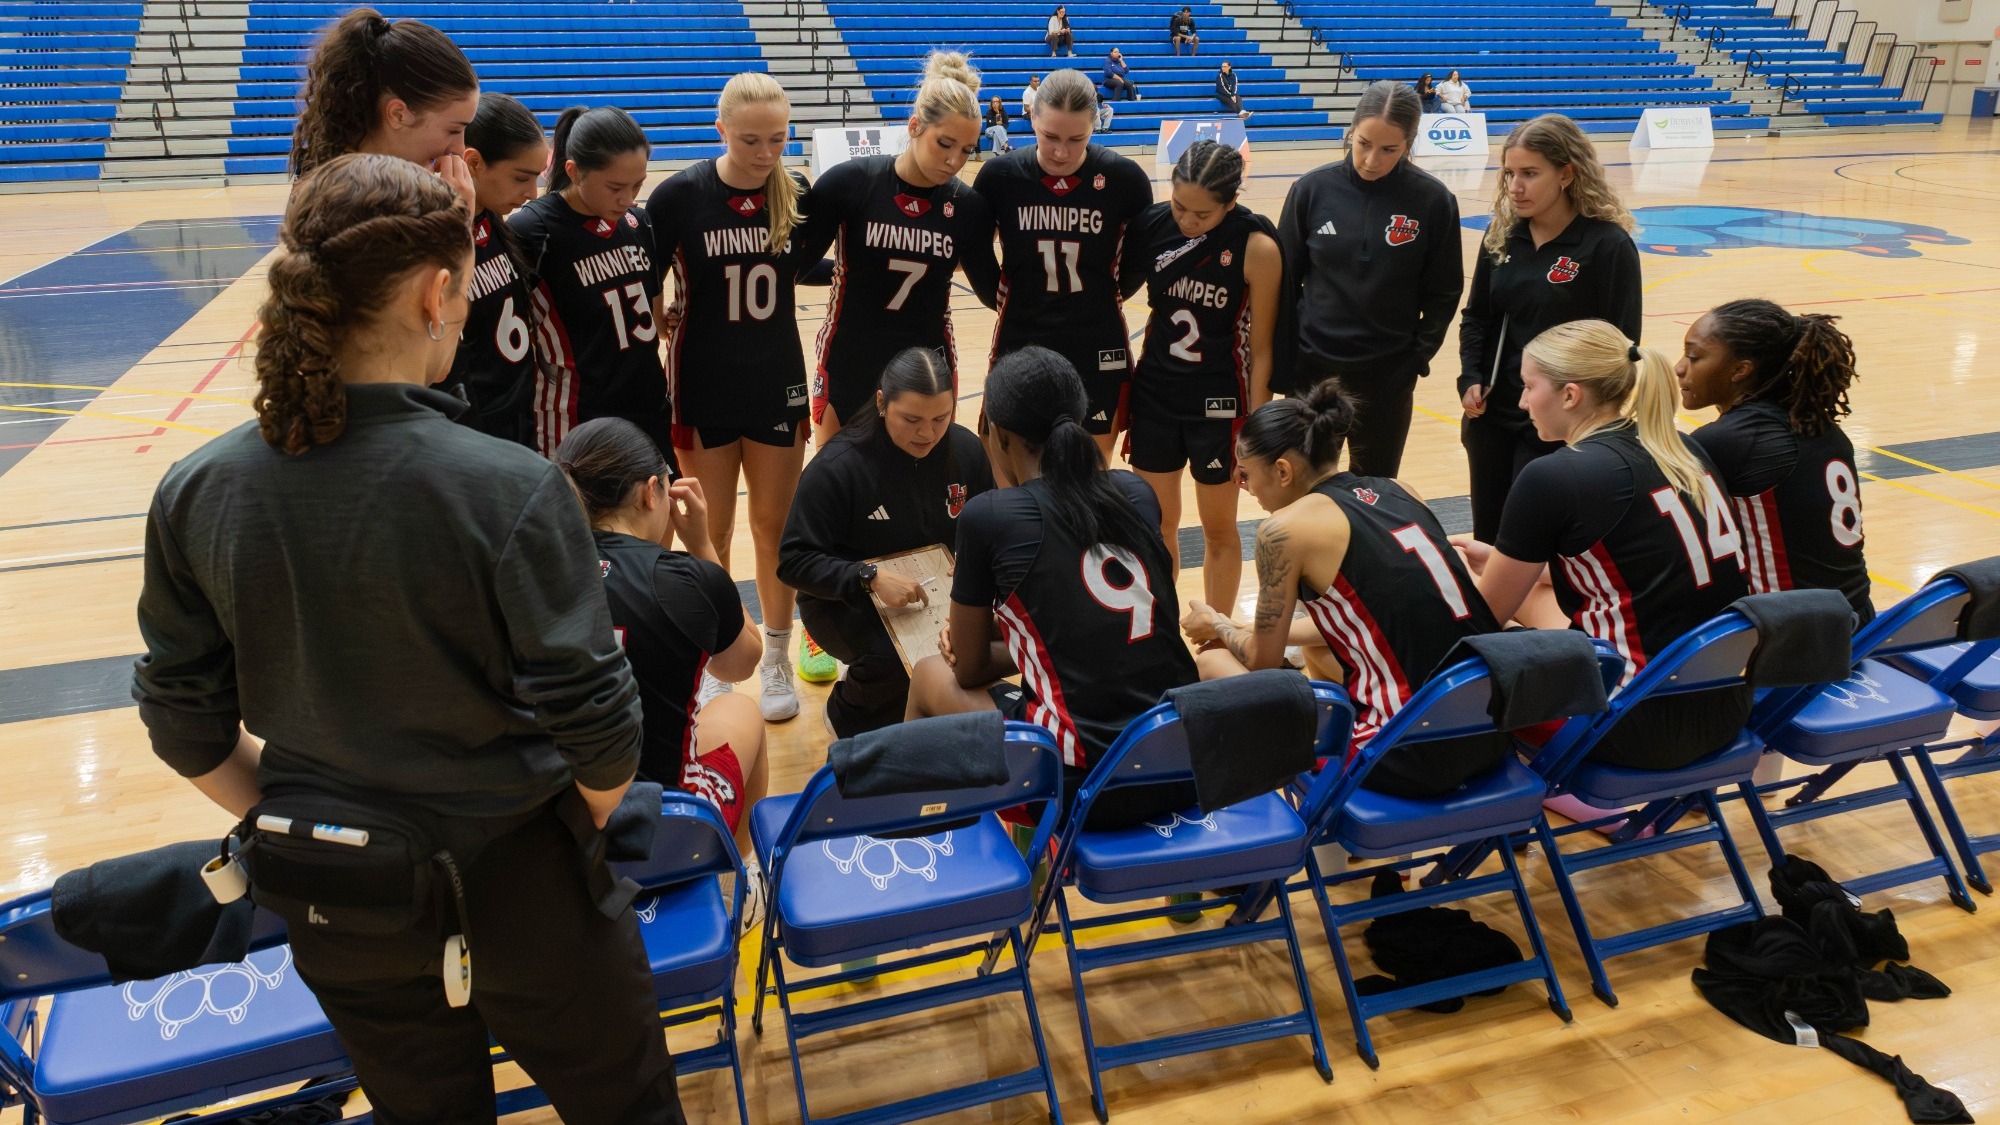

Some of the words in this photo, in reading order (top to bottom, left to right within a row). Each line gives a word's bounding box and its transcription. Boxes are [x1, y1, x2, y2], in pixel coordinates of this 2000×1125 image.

[849, 146, 881, 156] SPORTS
[1428, 129, 1472, 141] OUA
[865, 221, 954, 259] WINNIPEG
[1017, 205, 1103, 235] WINNIPEG
[724, 263, 778, 322] 10
[885, 258, 928, 311] 7
[1037, 239, 1084, 293] 11
[495, 295, 531, 364] 6
[602, 280, 658, 350] 13
[1169, 308, 1202, 363] 2
[1650, 471, 1748, 590] 14
[1825, 458, 1863, 548] 8
[1080, 542, 1156, 645] 9
[1390, 522, 1472, 621] 1
